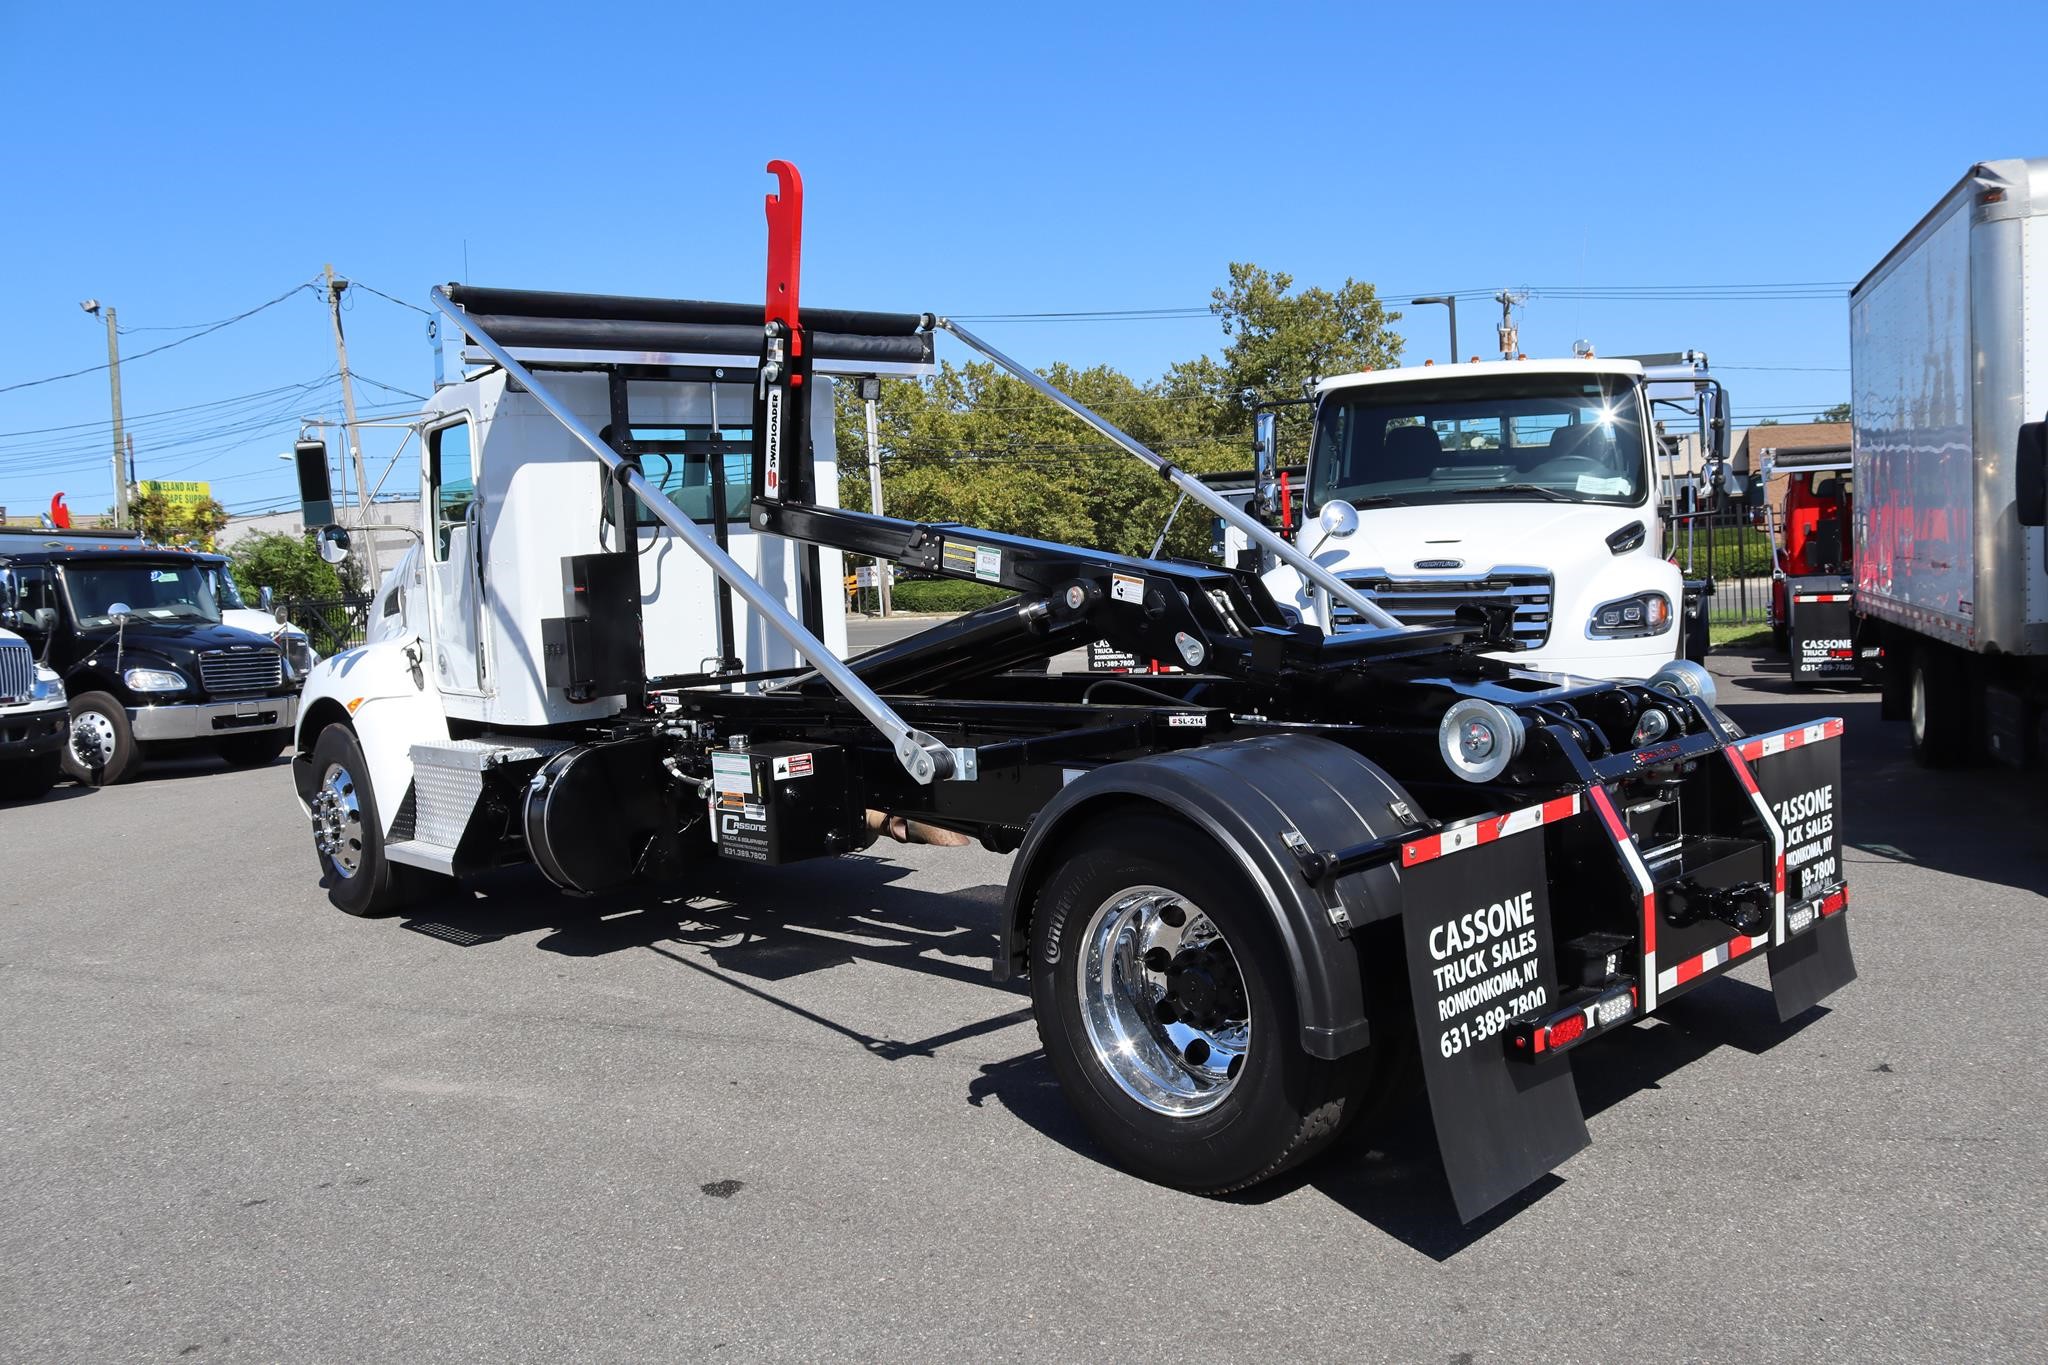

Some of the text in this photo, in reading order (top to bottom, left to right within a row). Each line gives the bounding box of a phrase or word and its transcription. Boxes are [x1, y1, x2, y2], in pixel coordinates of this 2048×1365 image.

[769, 394, 779, 468] SWAPLOADER
[149, 481, 199, 492] LAKELAND AVE
[1801, 639, 1853, 649] CASSONE
[1802, 649, 1828, 657] TRUCK
[1093, 660, 1135, 668] 631-389-7800
[721, 814, 767, 835] CASSONE
[1806, 813, 1833, 839] SALES
[1823, 835, 1833, 853] NY
[1429, 891, 1535, 961] CASSONE
[1433, 929, 1537, 992] TRUCK SALES
[1438, 958, 1539, 1021] RONKONKOMA, NY
[1440, 986, 1547, 1059] 631-389-7800
